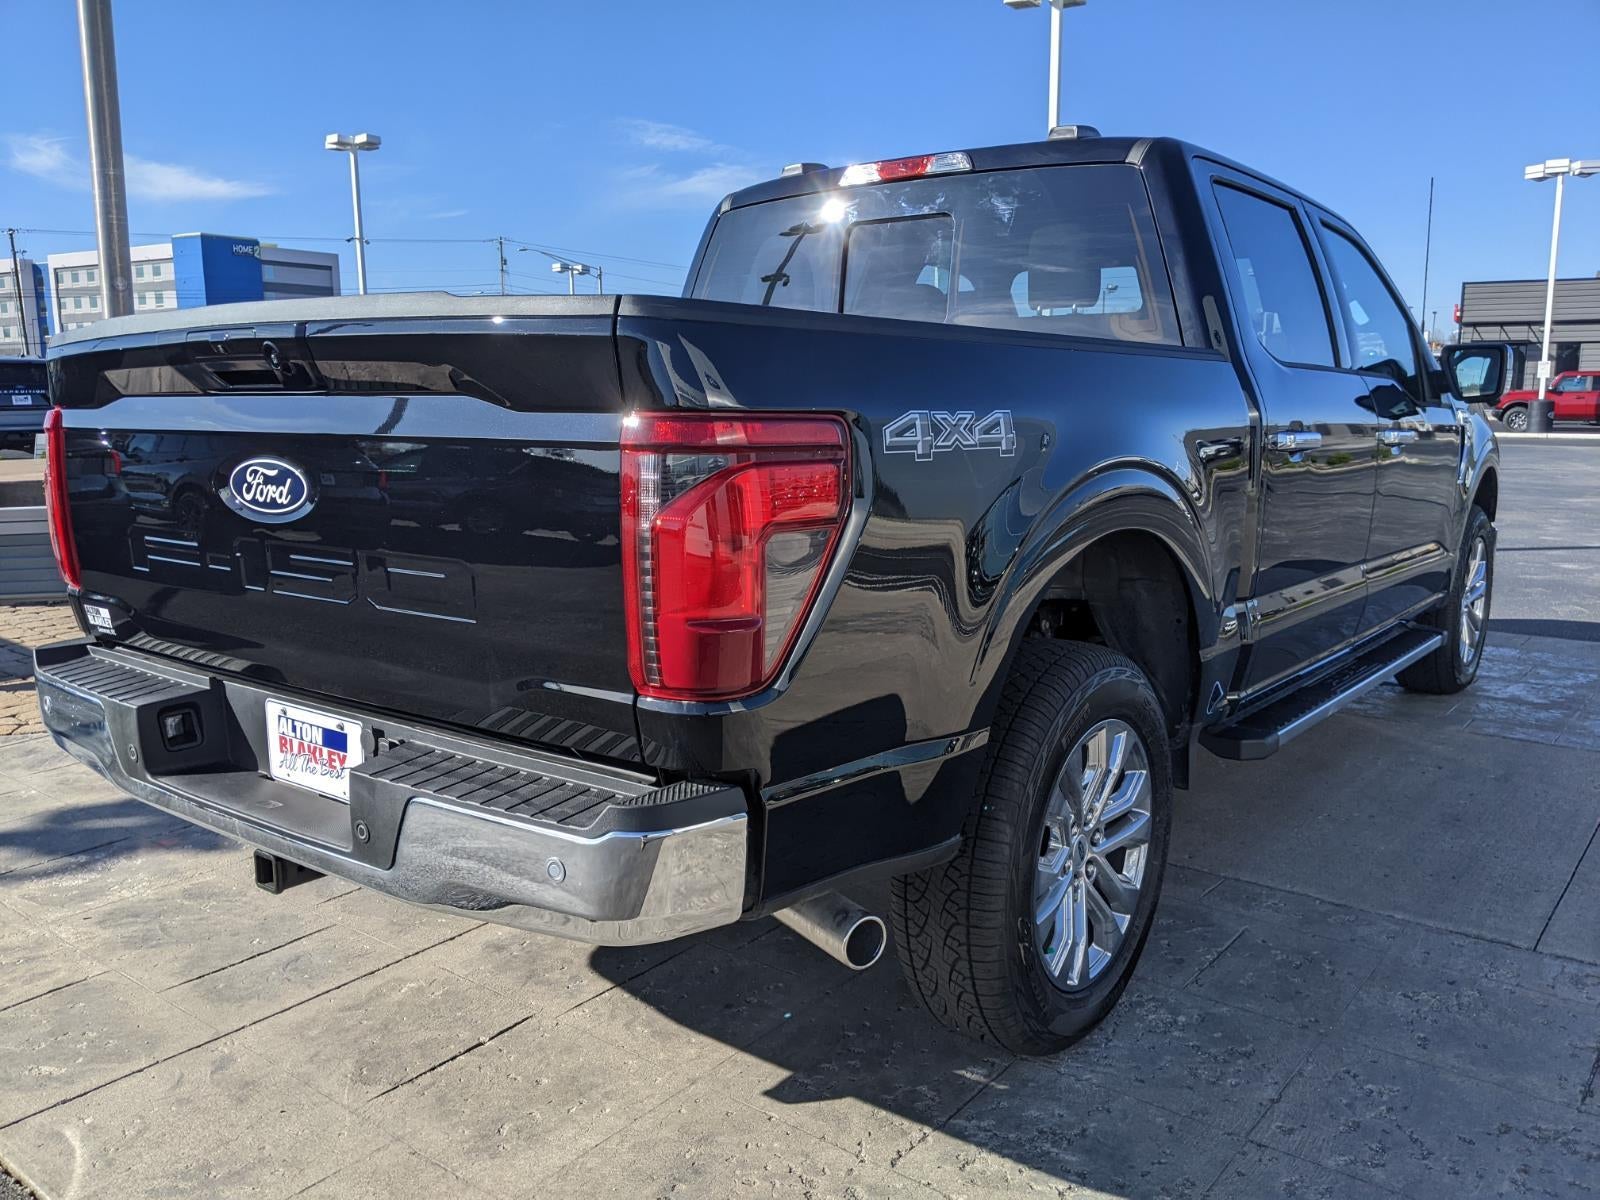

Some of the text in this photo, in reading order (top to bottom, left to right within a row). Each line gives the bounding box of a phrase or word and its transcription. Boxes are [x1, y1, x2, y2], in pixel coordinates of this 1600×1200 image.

[242, 466, 292, 505] Ford
[278, 716, 323, 746] ALTON
[279, 734, 348, 770] BLAKLEY
[299, 753, 318, 776] The
[318, 757, 347, 780] Best
